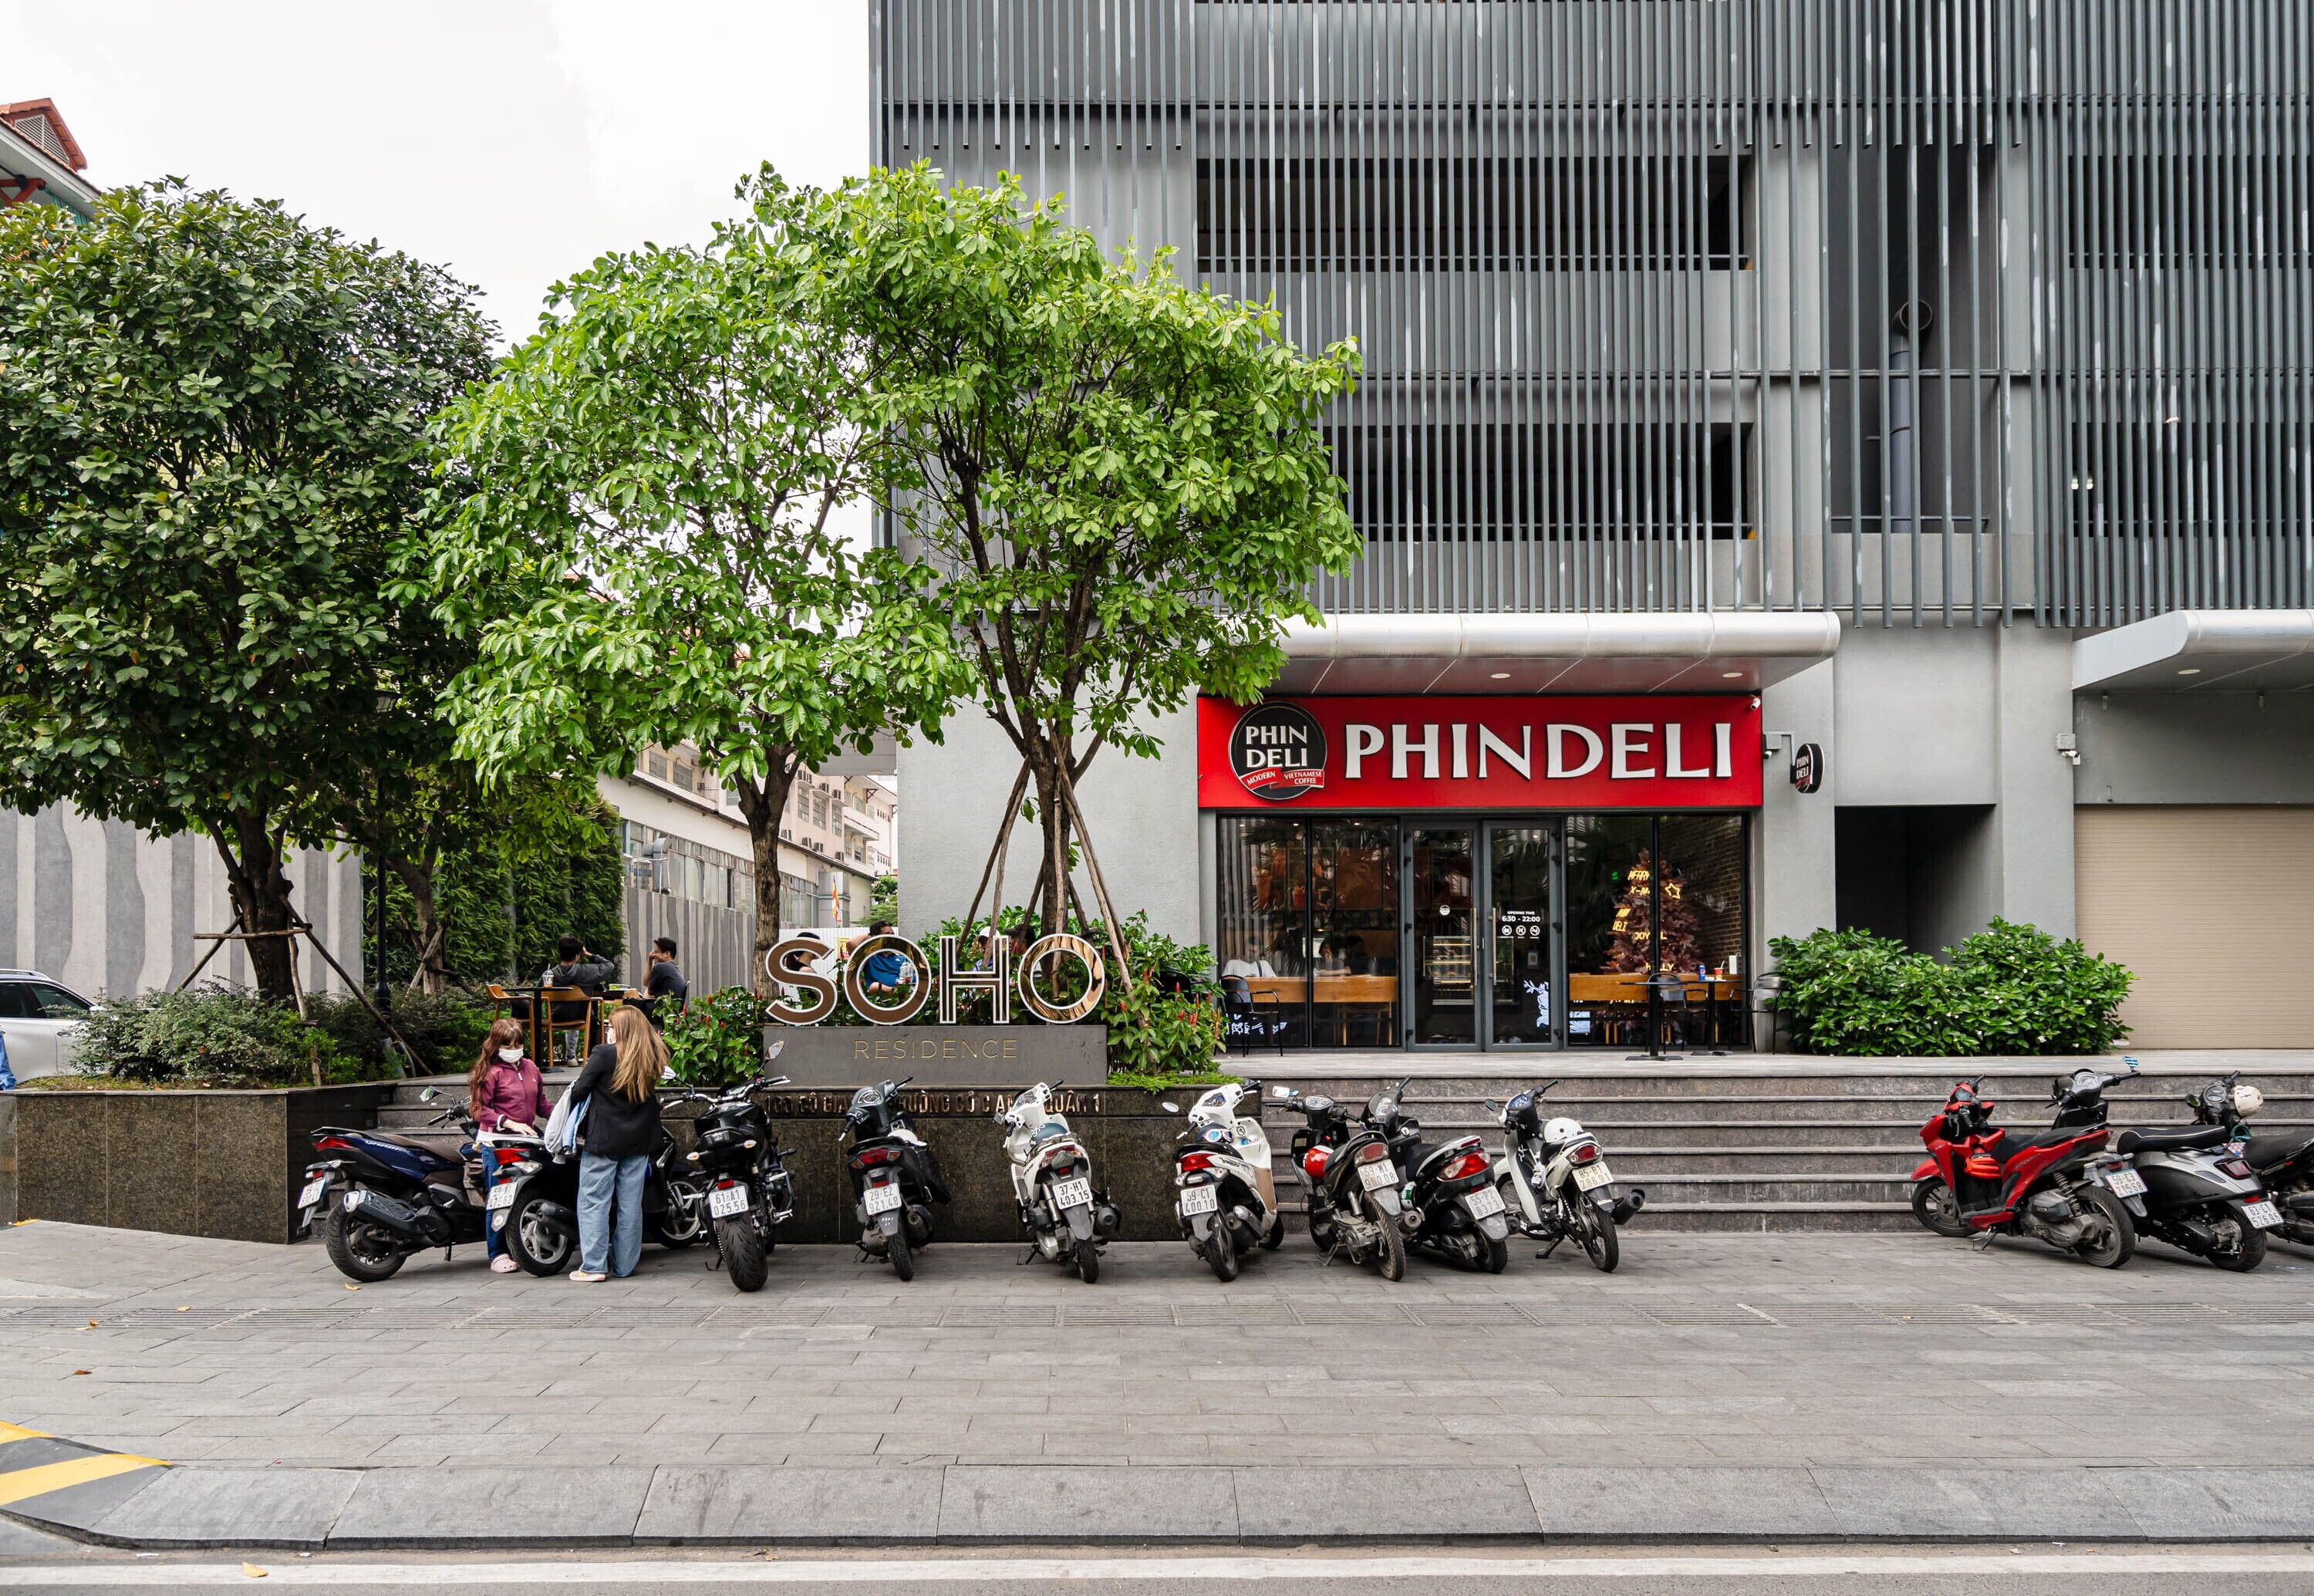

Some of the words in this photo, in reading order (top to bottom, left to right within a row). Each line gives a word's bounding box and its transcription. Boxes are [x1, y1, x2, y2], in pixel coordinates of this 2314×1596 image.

[1246, 725, 1308, 745] PHIN
[1246, 747, 1308, 768] DELI
[1345, 723, 1732, 781] PHINDELI
[1246, 771, 1277, 785] MODERN
[1283, 771, 1323, 781] VIETNAMESE
[764, 933, 1106, 1025] SOHO
[853, 1039, 1018, 1059] RESIDENCE
[1093, 1093, 1100, 1113] 1
[1059, 1181, 1084, 1196] 37-H1
[869, 1196, 899, 1213] 921.48
[1060, 1190, 1090, 1206] 403.15
[713, 1200, 746, 1216] 025.56
